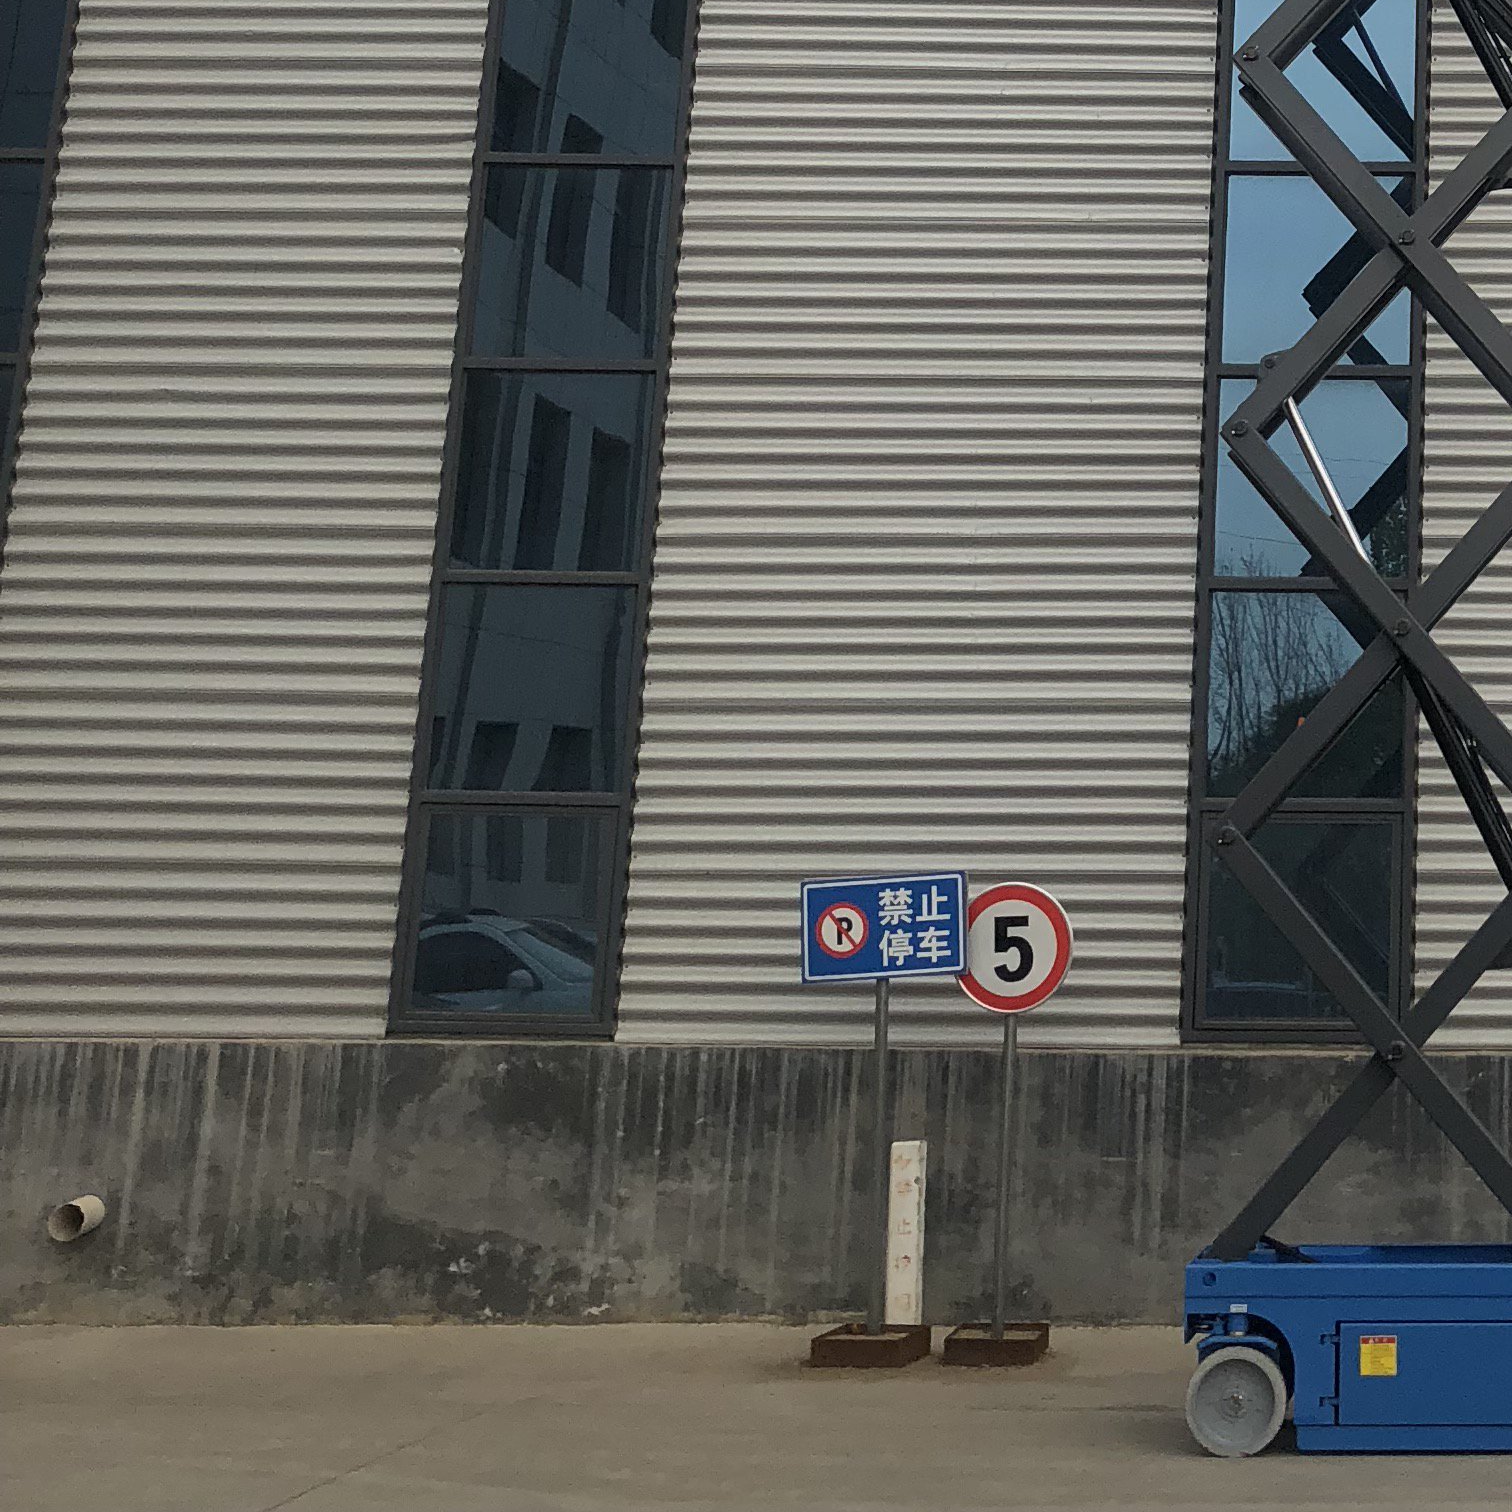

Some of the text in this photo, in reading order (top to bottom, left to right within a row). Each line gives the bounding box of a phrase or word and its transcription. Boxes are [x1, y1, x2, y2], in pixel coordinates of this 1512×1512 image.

[878, 885, 951, 926] 禁止
[879, 927, 952, 967] 停车
[993, 916, 1033, 982] 5
